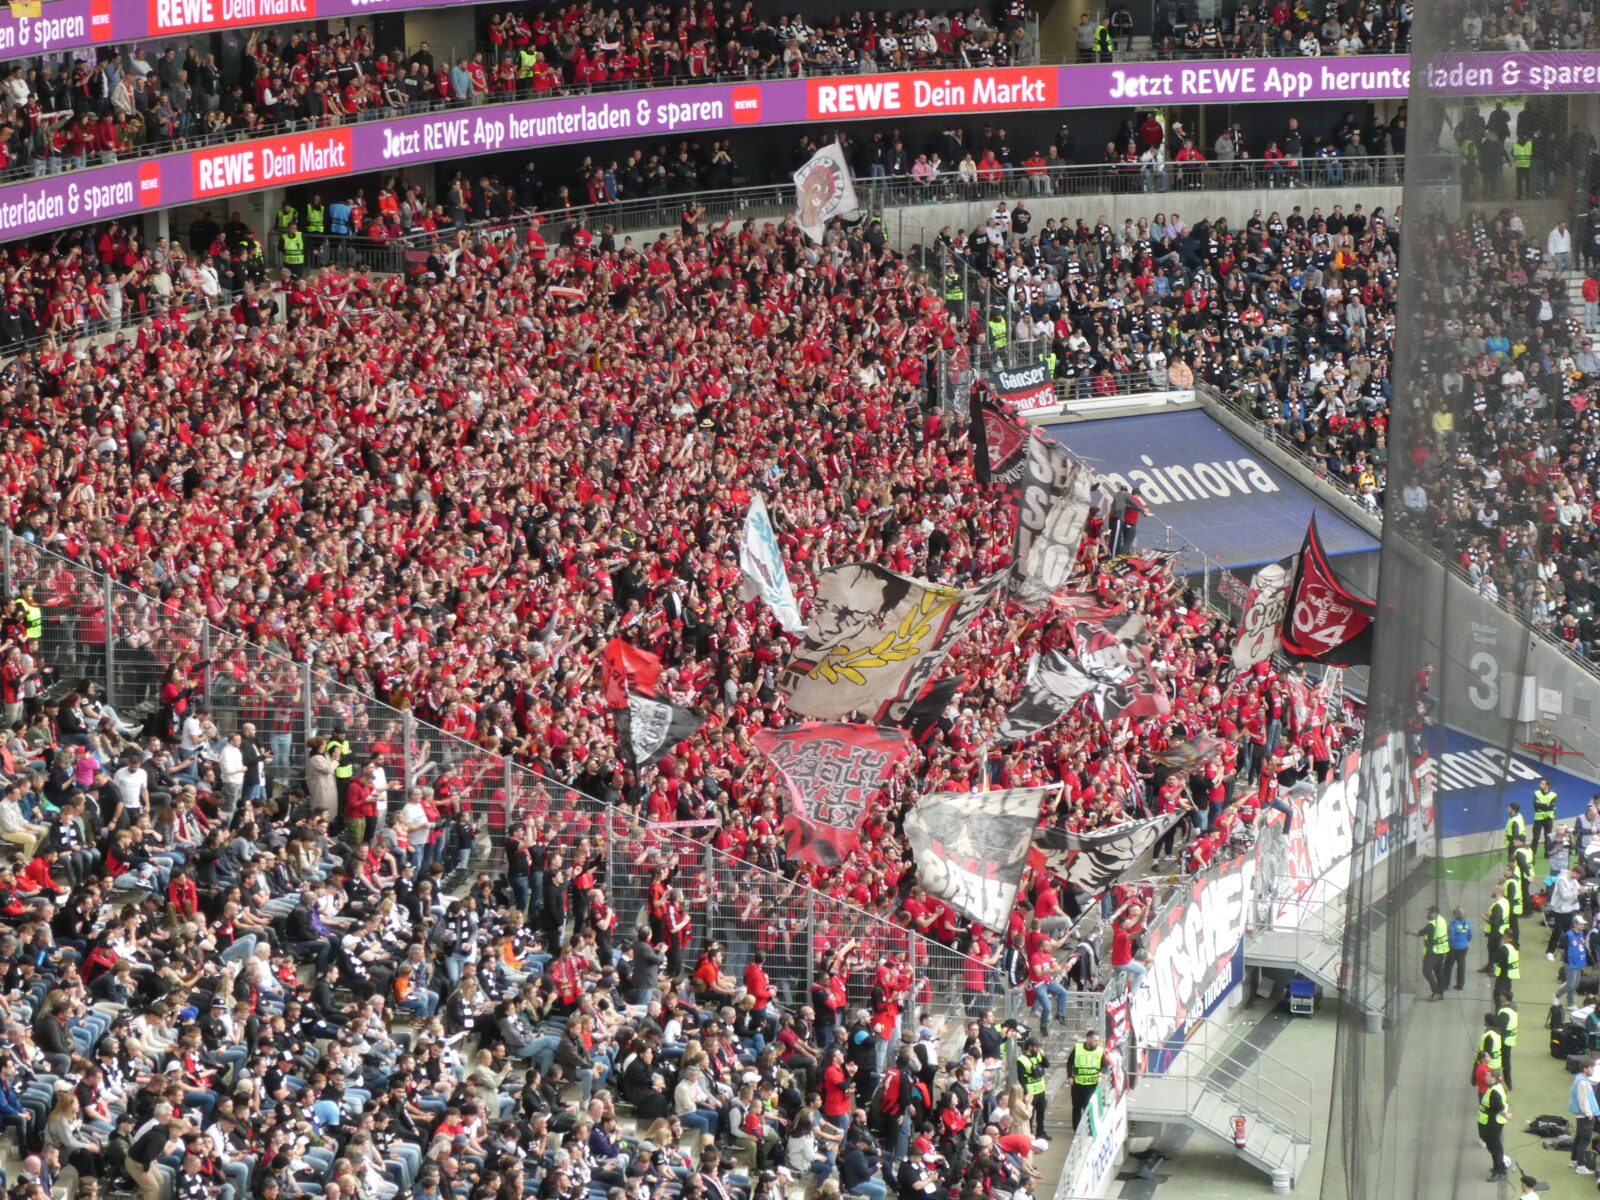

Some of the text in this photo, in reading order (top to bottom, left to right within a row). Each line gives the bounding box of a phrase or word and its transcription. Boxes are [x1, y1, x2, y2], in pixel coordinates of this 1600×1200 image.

[34, 15, 84, 49] sparen
[92, 14, 110, 25] REWE
[157, 0, 214, 27] REWE
[818, 76, 1045, 113] REWE Dein Markt
[1110, 71, 1172, 97] Jetzt
[1182, 68, 1255, 94] REWE
[1264, 67, 1312, 97] App
[1502, 61, 1520, 85] &
[1529, 64, 1600, 90] spare
[383, 98, 758, 158] Jetzt REWE App herunterladen & sparen REWE
[200, 138, 345, 190] REWE Dein Markt
[68, 183, 79, 213] &
[83, 181, 133, 215] sparen
[141, 178, 158, 190] REWE
[1094, 454, 1280, 504] mainova
[1293, 600, 1347, 647] 04
[1469, 652, 1499, 711] 3
